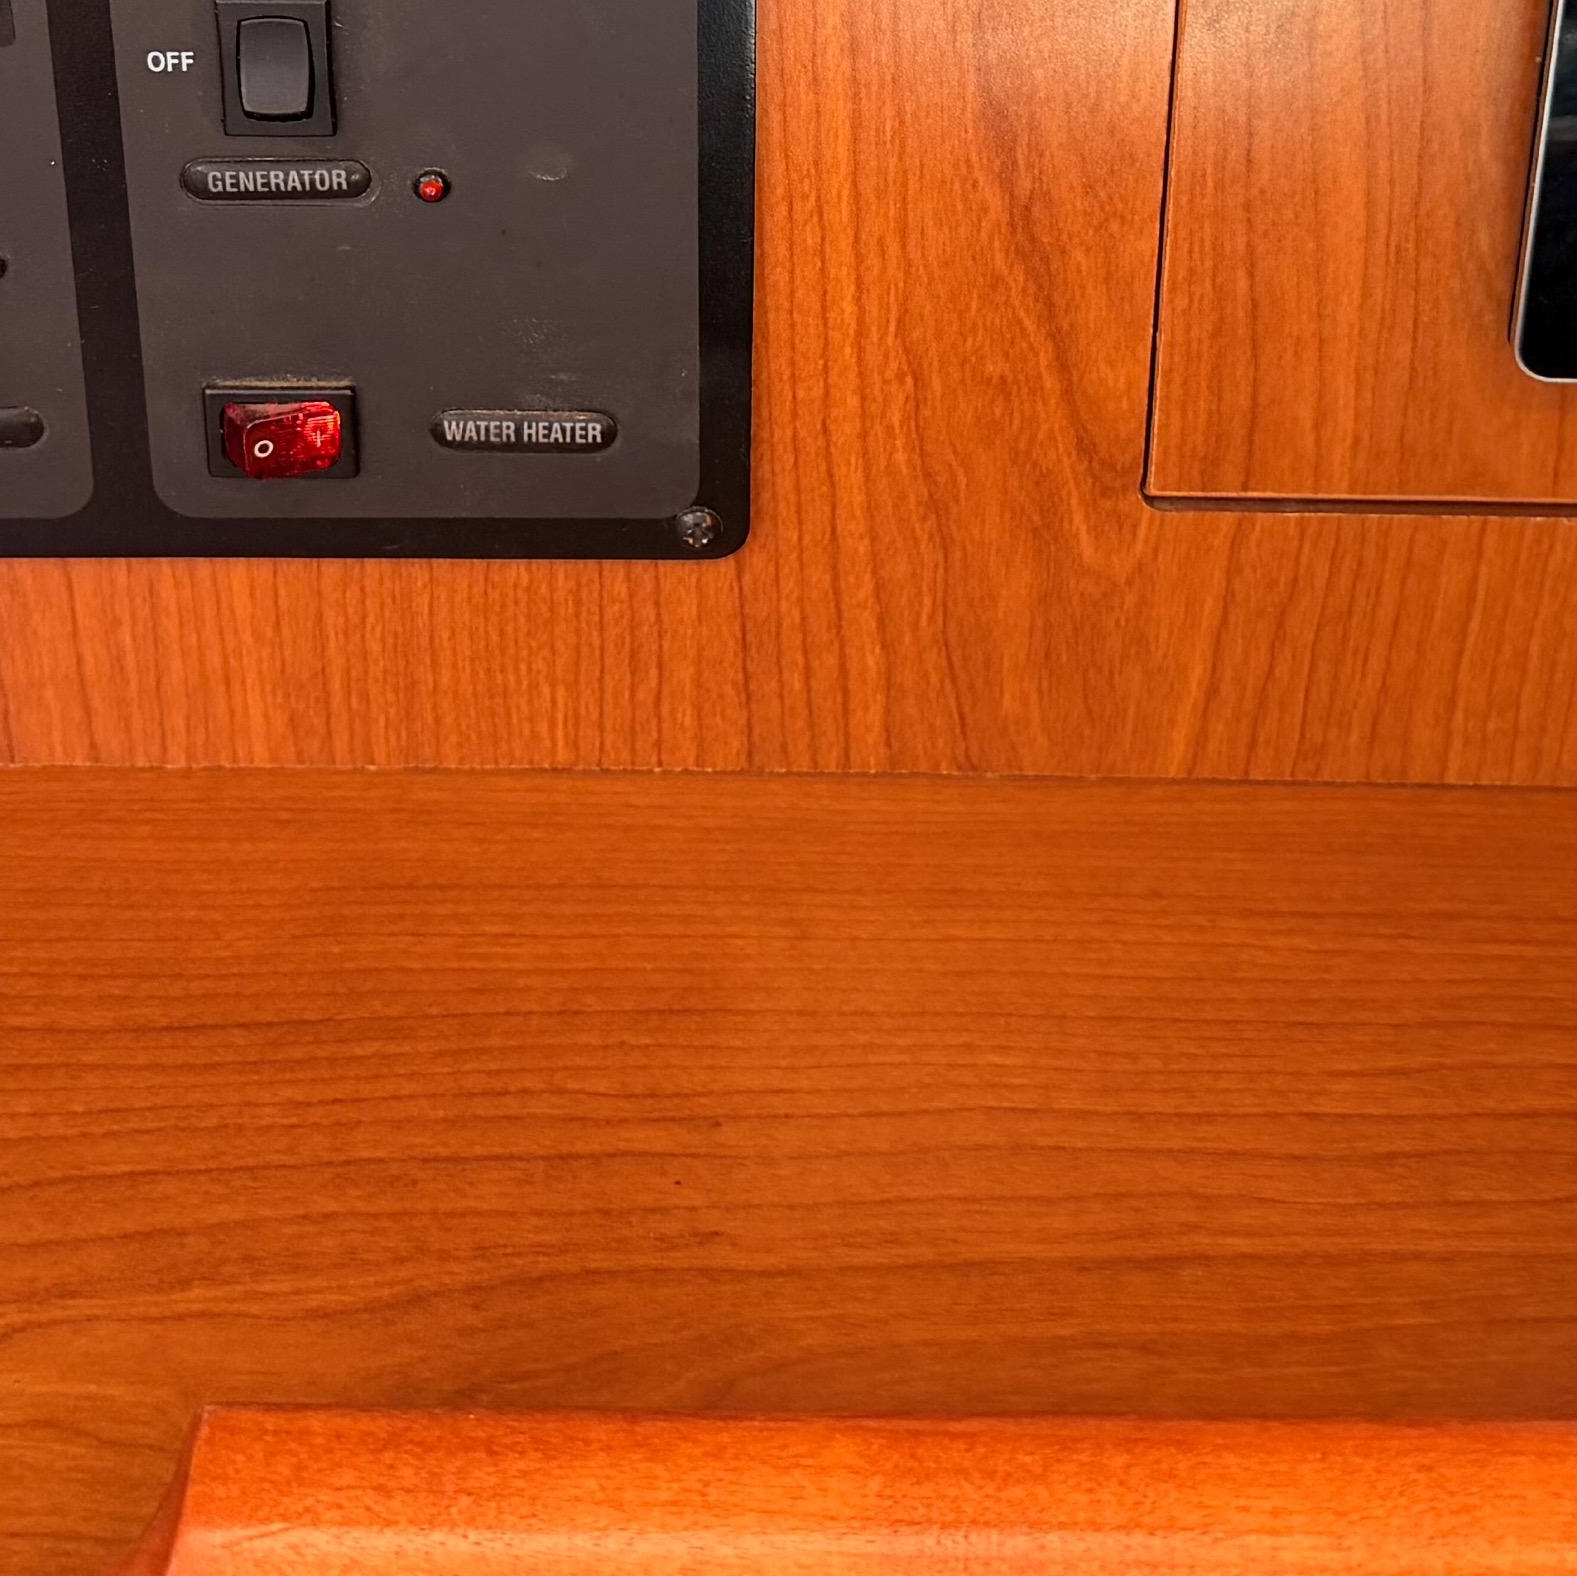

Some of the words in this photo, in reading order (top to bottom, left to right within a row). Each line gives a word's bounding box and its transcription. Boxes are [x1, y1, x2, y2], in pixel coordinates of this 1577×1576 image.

[147, 50, 195, 73] OFF
[207, 169, 348, 192] GENERATOR
[443, 421, 517, 444] WATER
[523, 421, 603, 445] HEATER
